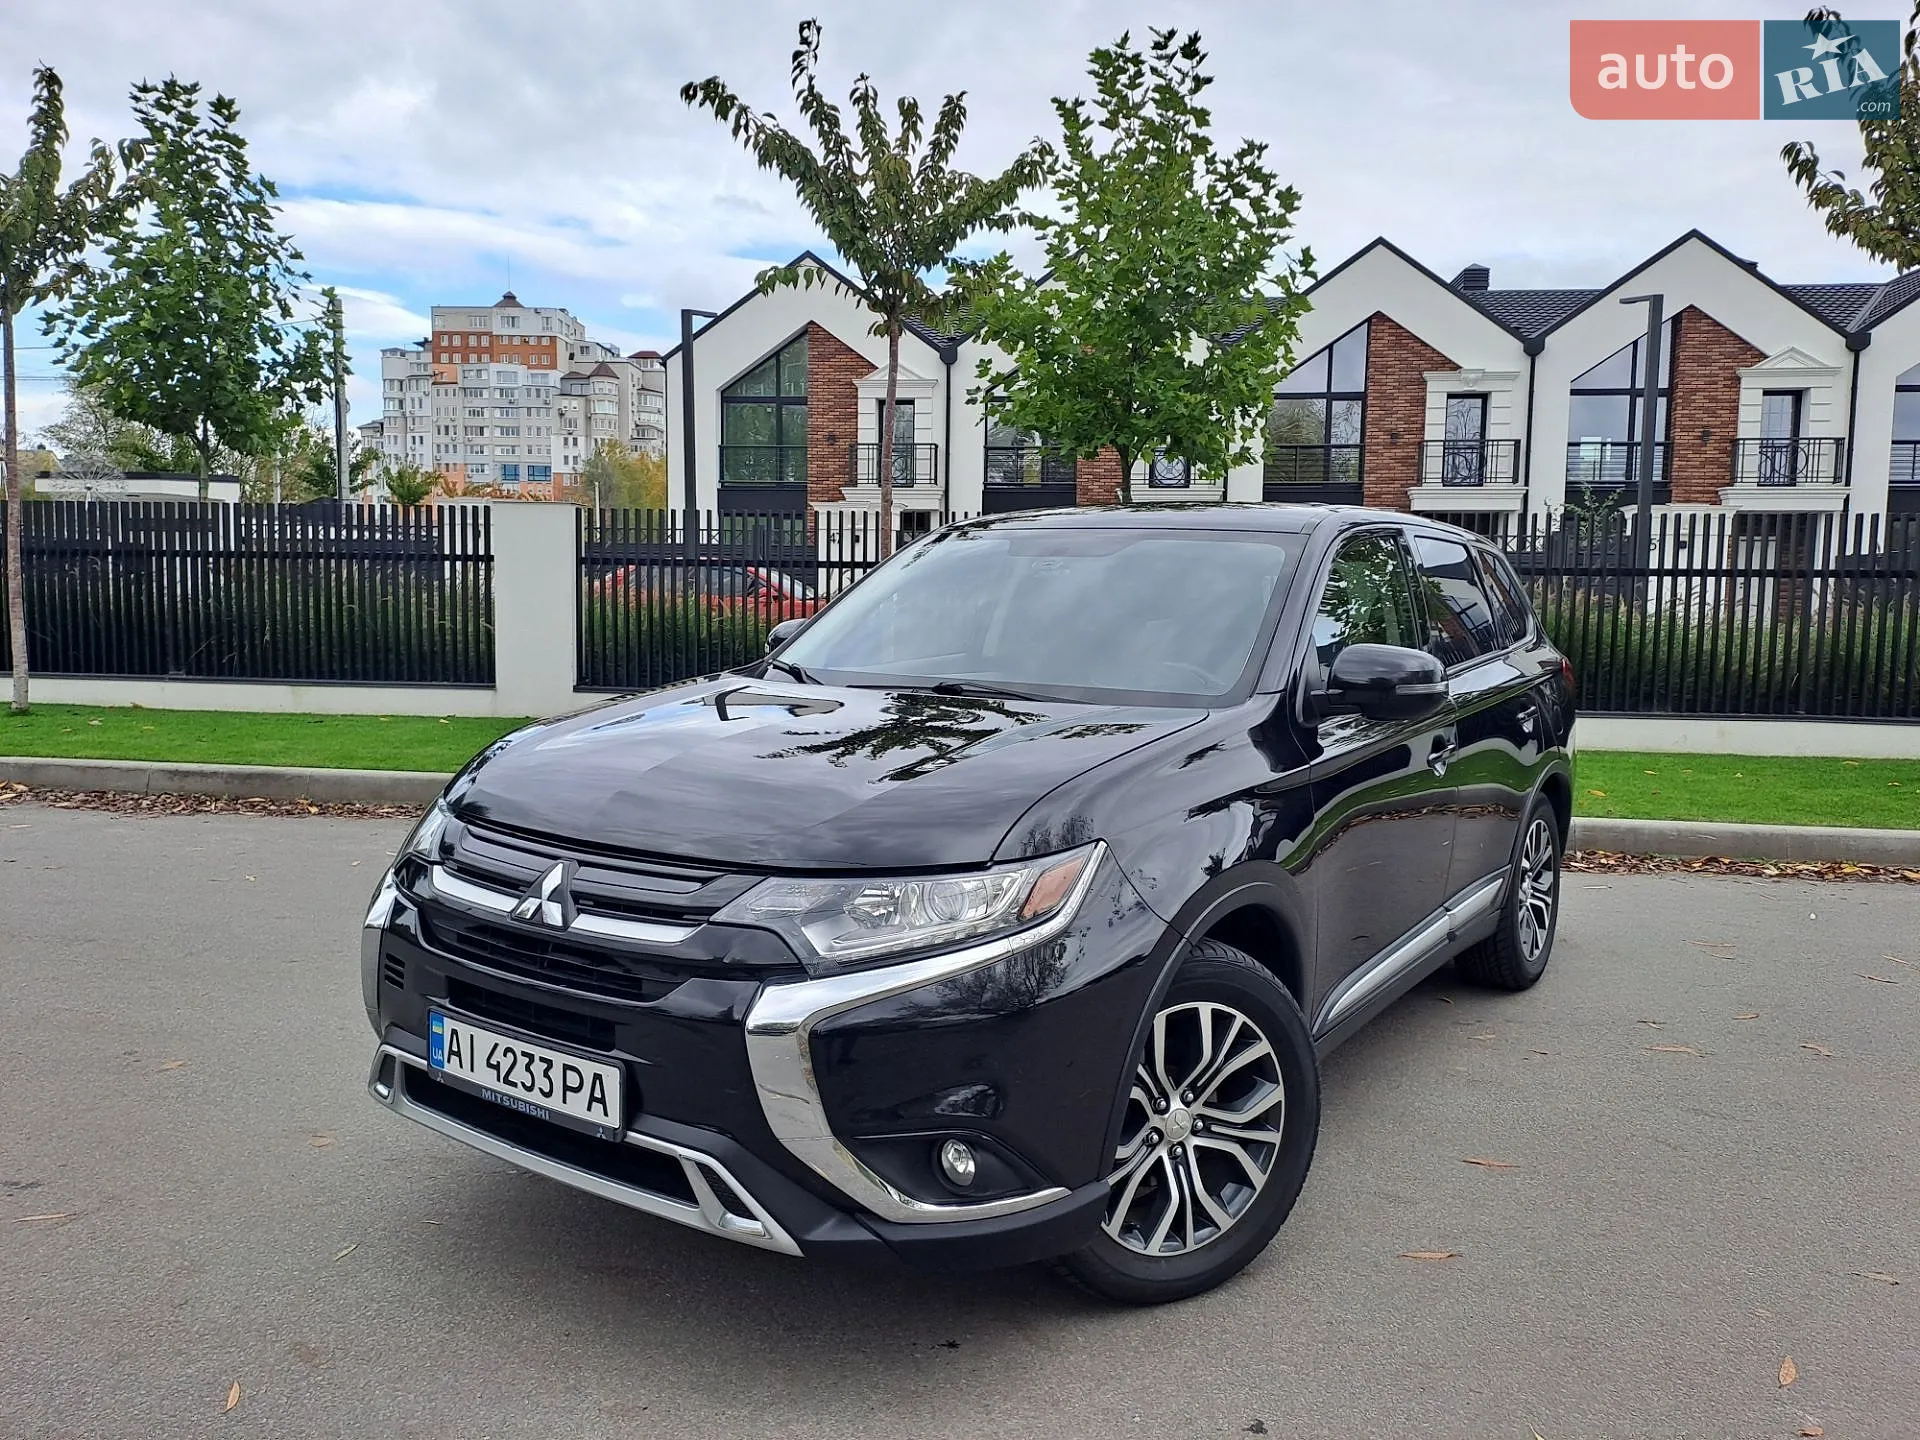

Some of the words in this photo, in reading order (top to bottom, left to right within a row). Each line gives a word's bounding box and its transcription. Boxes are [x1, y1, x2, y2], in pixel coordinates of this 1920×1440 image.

[432, 1047, 444, 1061] UA
[446, 1028, 475, 1073] AI
[486, 1042, 554, 1099] 4233
[562, 1062, 609, 1118] PA
[481, 1088, 550, 1121] MITSUBISHI
